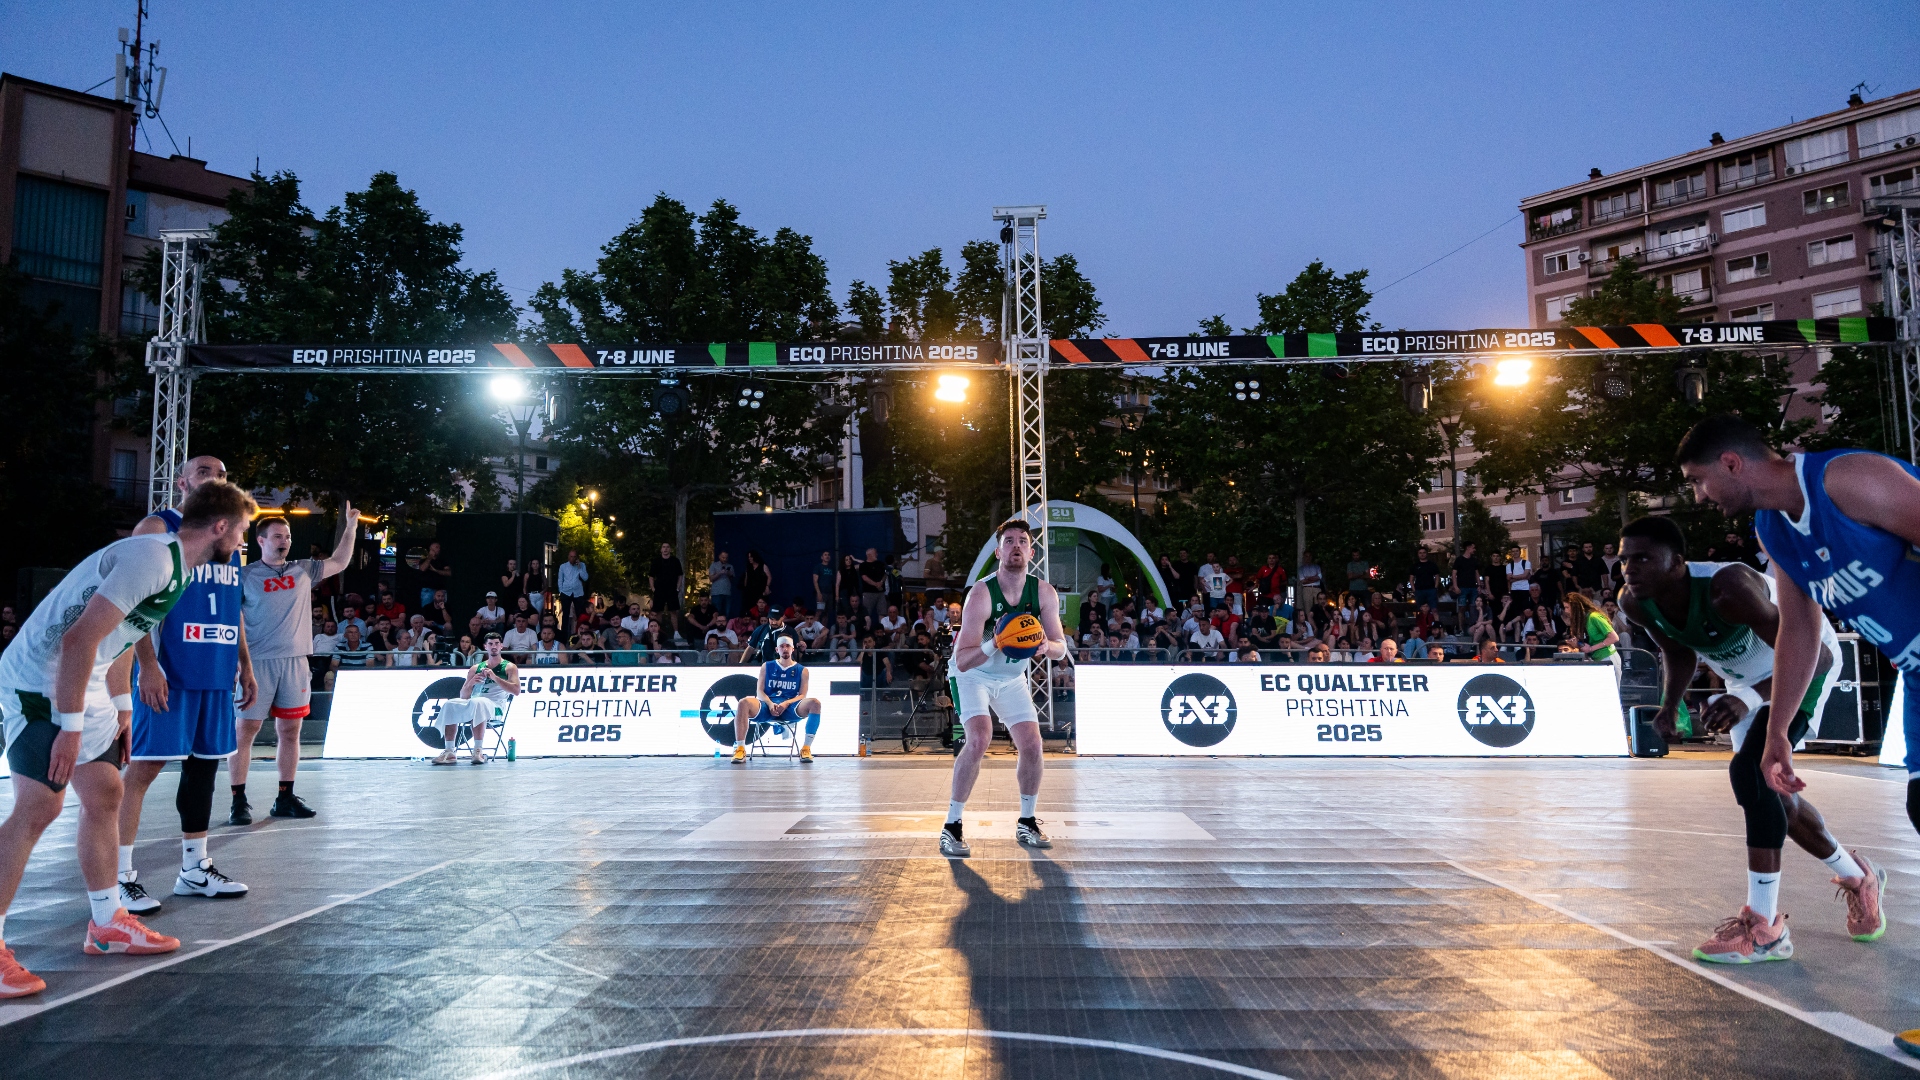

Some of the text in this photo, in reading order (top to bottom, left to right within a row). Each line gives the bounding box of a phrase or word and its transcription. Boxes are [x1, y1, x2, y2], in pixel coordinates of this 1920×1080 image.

[1362, 331, 1556, 354] ECQ PRISHTINA 2025
[1681, 326, 1765, 344] 7-8 JUNE
[292, 349, 476, 367] ECQ PRISHTINA 2025
[596, 349, 675, 365] 7-8 JUNE
[789, 345, 978, 364] ECQ PRISHTINA 2025
[1148, 341, 1230, 358] 7-8 JUNE
[191, 564, 239, 586] YPRUS
[208, 592, 217, 615] 1
[203, 627, 236, 641] EKO
[519, 676, 543, 694] EC
[549, 675, 678, 697] QUALIFIER
[767, 679, 797, 690] CYPRUS
[1260, 674, 1429, 695] EC QUALIFIER
[533, 699, 652, 718] PRISHTINA
[1286, 699, 1410, 717] PRISHTINA
[557, 724, 622, 743] 2025
[1316, 724, 1383, 742] 2025
